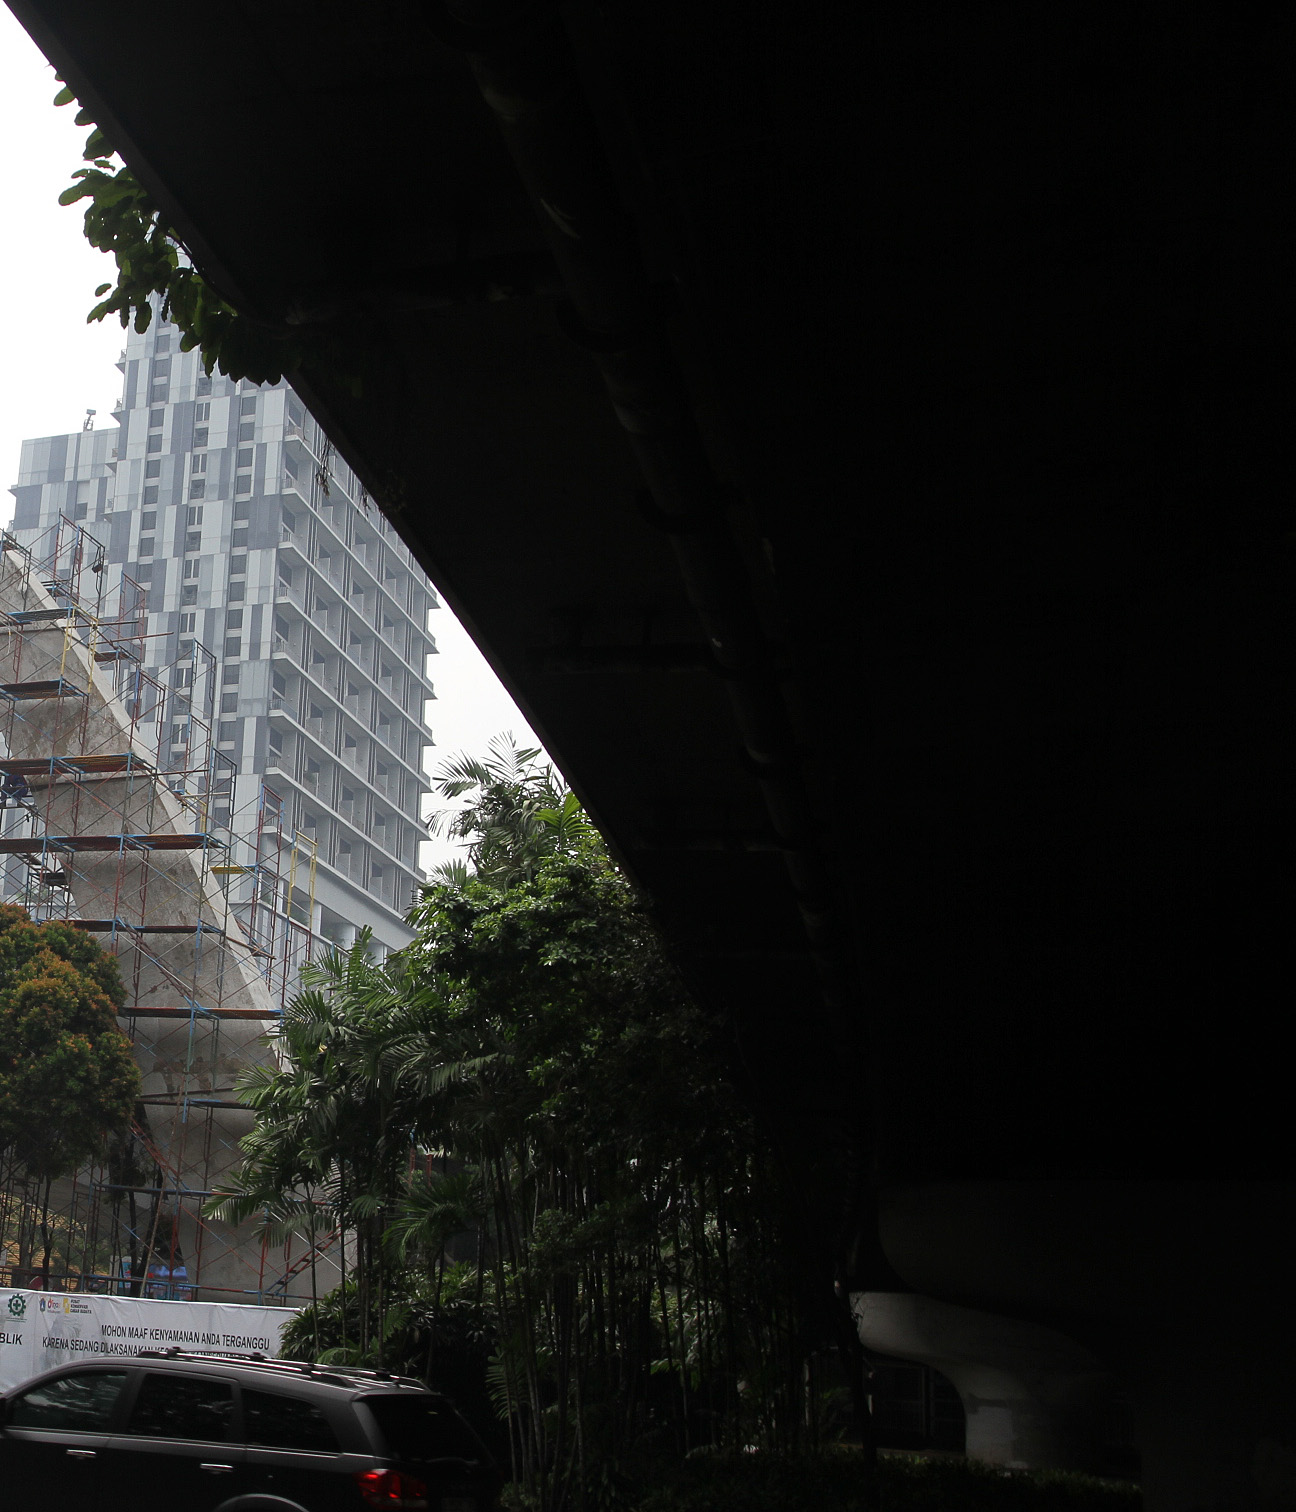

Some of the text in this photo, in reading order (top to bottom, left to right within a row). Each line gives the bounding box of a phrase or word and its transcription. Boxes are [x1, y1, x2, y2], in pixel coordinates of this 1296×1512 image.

[43, 1336, 69, 1350] KARENA
[70, 1339, 99, 1353] SEDANG
[101, 1324, 270, 1351] MOHON MAAF KENYAMANAN ANDA TERGANGGU
